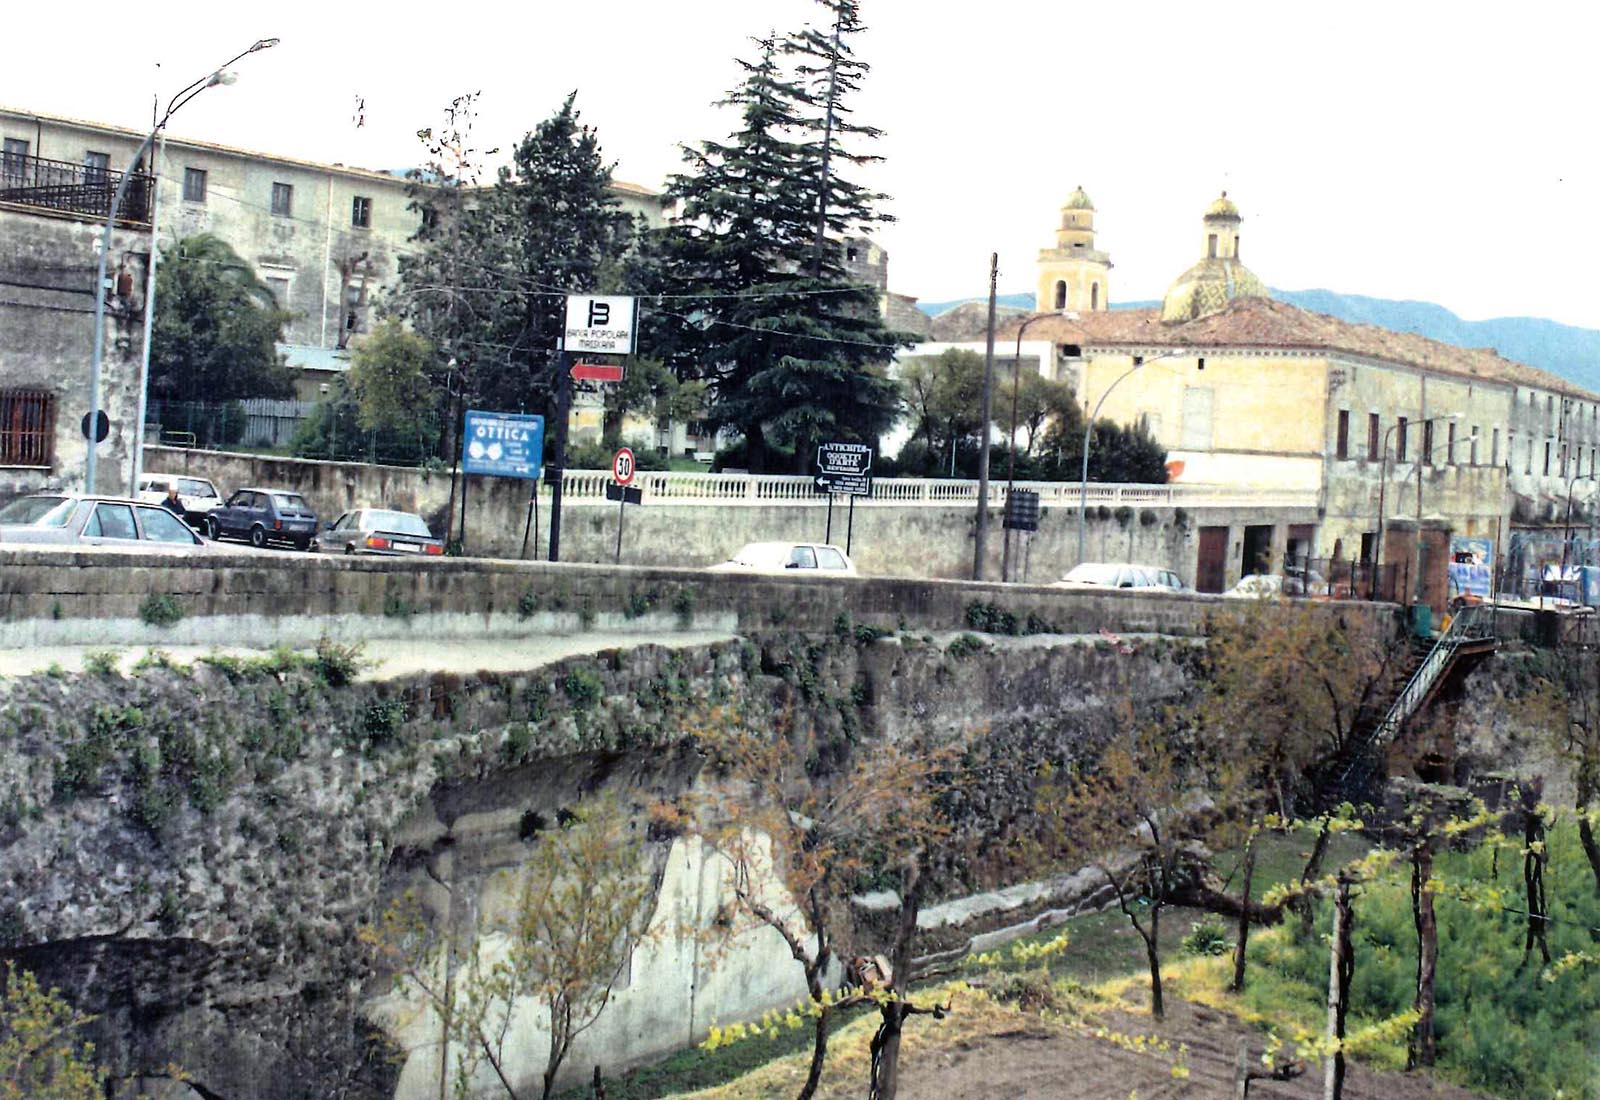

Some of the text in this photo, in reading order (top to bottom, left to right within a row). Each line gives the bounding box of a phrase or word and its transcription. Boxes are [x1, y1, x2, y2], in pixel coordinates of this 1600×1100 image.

[567, 329, 588, 338] BANCA
[476, 426, 529, 442] OTTICA
[827, 452, 862, 460] OGGETTI
[618, 457, 630, 476] 30
[829, 458, 858, 466] D'ARTE
